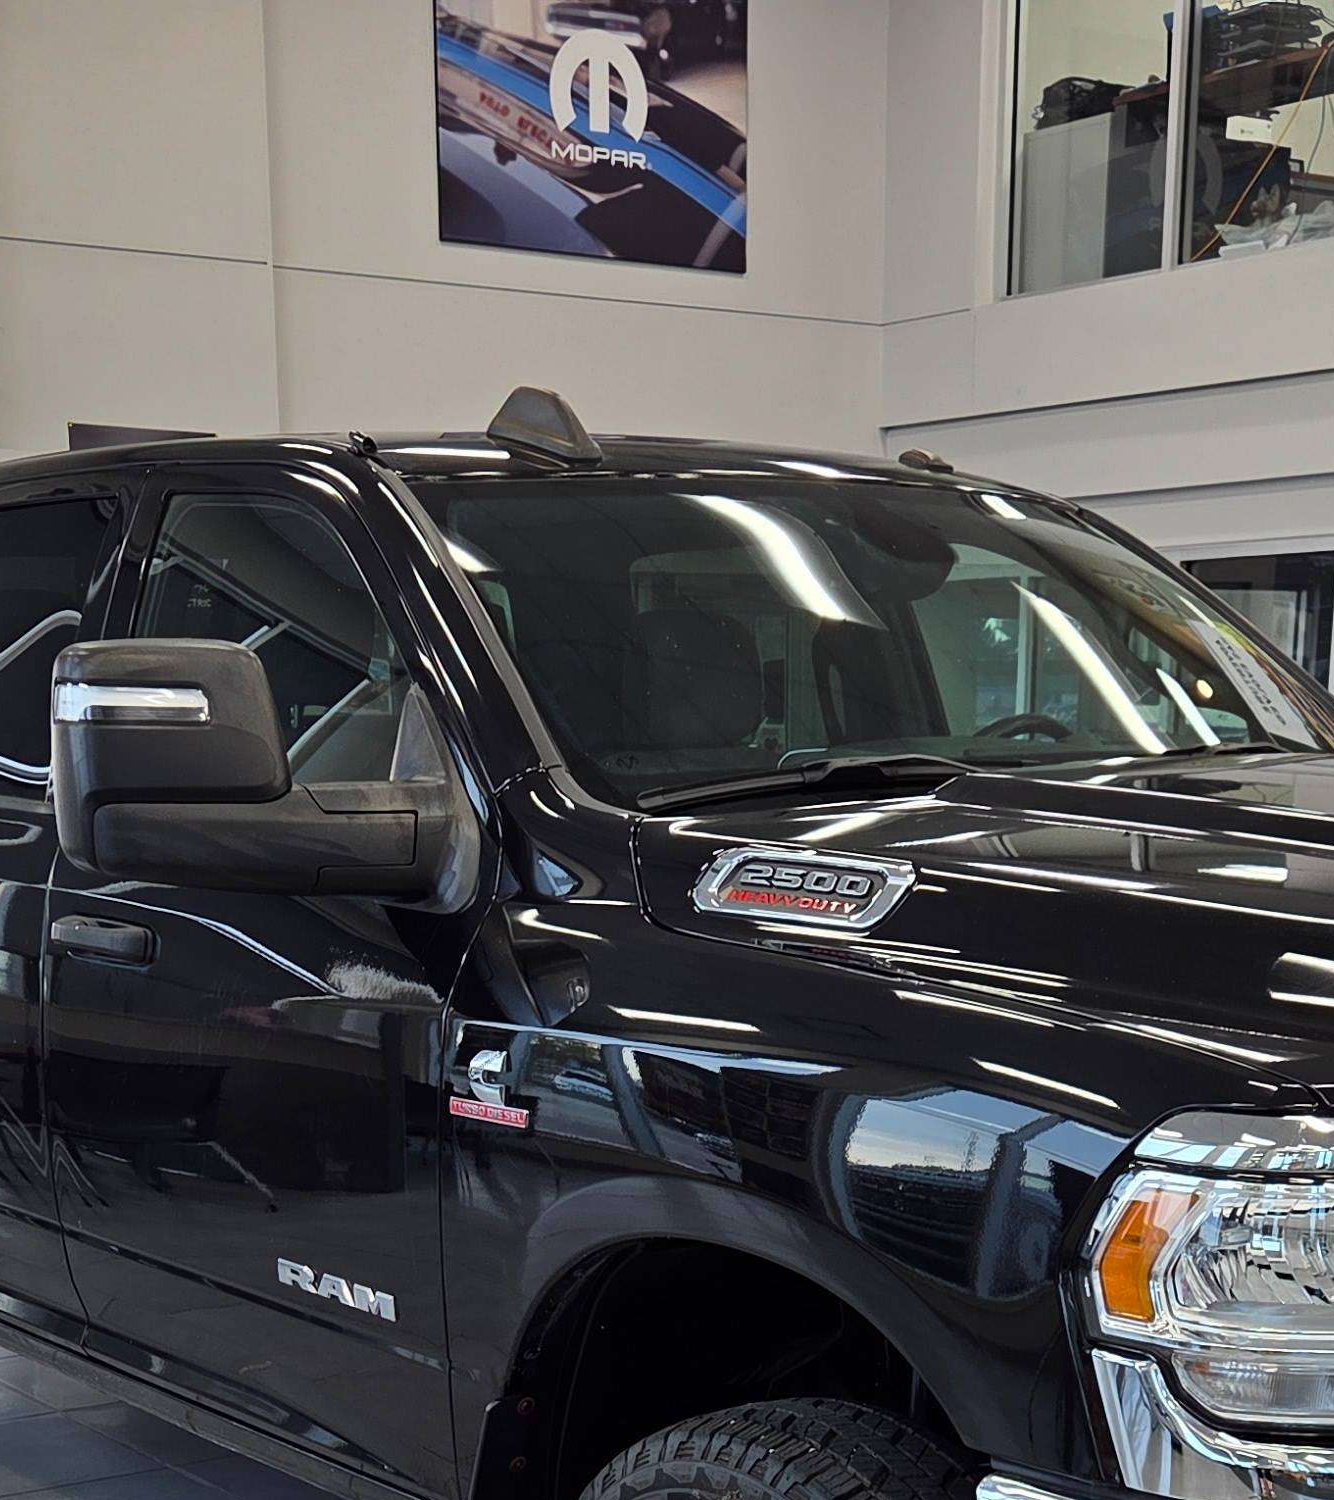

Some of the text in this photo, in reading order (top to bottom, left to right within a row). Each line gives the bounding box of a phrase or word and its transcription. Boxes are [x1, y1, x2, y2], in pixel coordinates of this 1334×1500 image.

[740, 864, 871, 897] 2500
[451, 1100, 527, 1124] TURBO DIESEL
[277, 1257, 396, 1323] RAM
